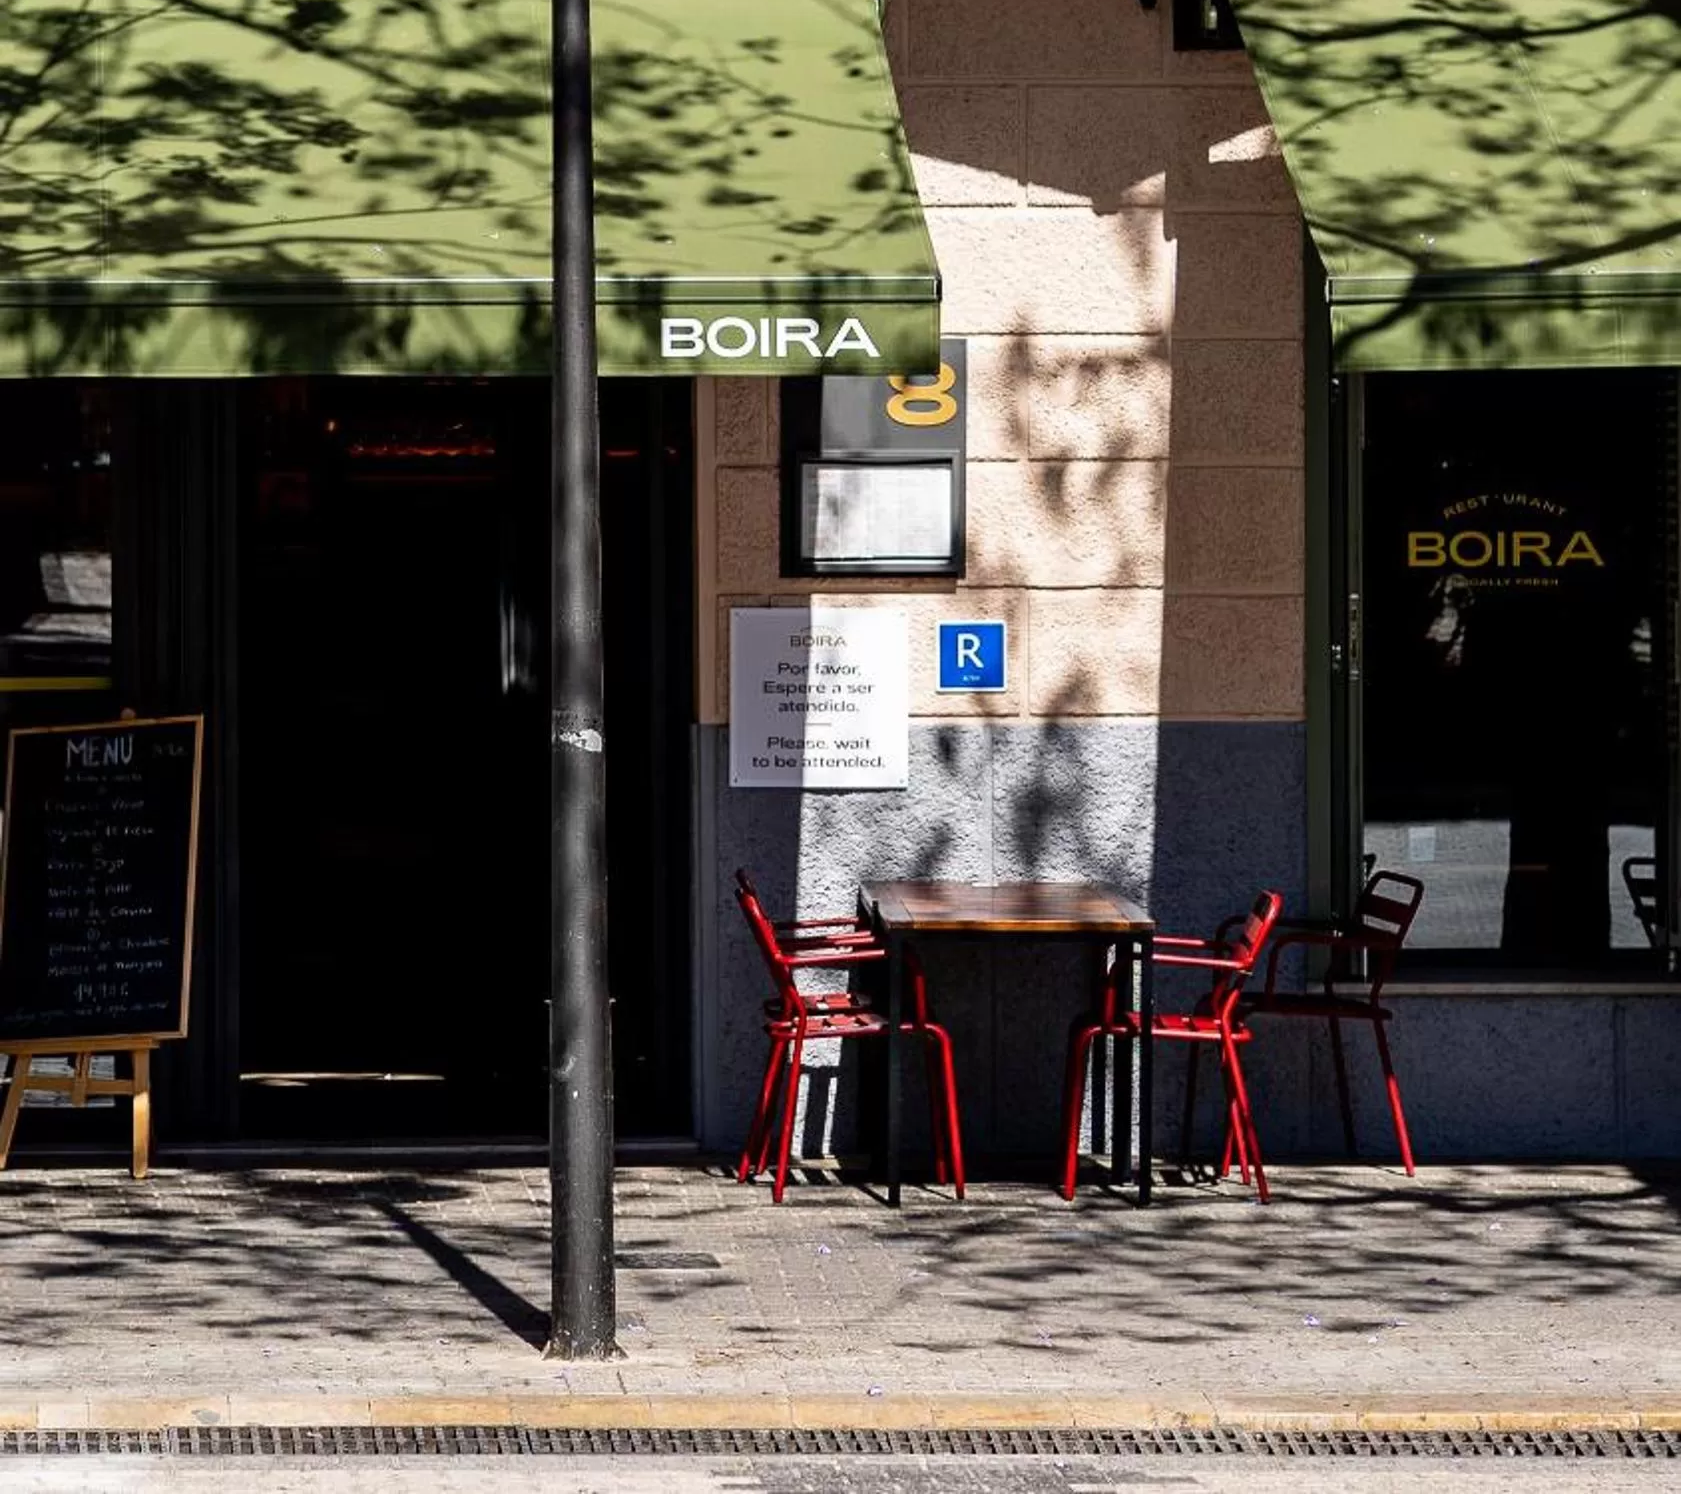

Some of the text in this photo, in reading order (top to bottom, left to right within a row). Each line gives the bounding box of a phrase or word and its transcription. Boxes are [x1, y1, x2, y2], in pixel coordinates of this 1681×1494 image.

[661, 317, 880, 357] BOIRA
[1407, 530, 1605, 567] BOIRA
[789, 635, 847, 647] BOIRA
[957, 633, 985, 668] R
[777, 662, 862, 677] Por favor,
[763, 680, 874, 696] Espere a ser
[778, 700, 860, 713] atendido.
[65, 733, 135, 769] MENU
[834, 737, 871, 750] wait
[752, 756, 886, 768] to be attended.
